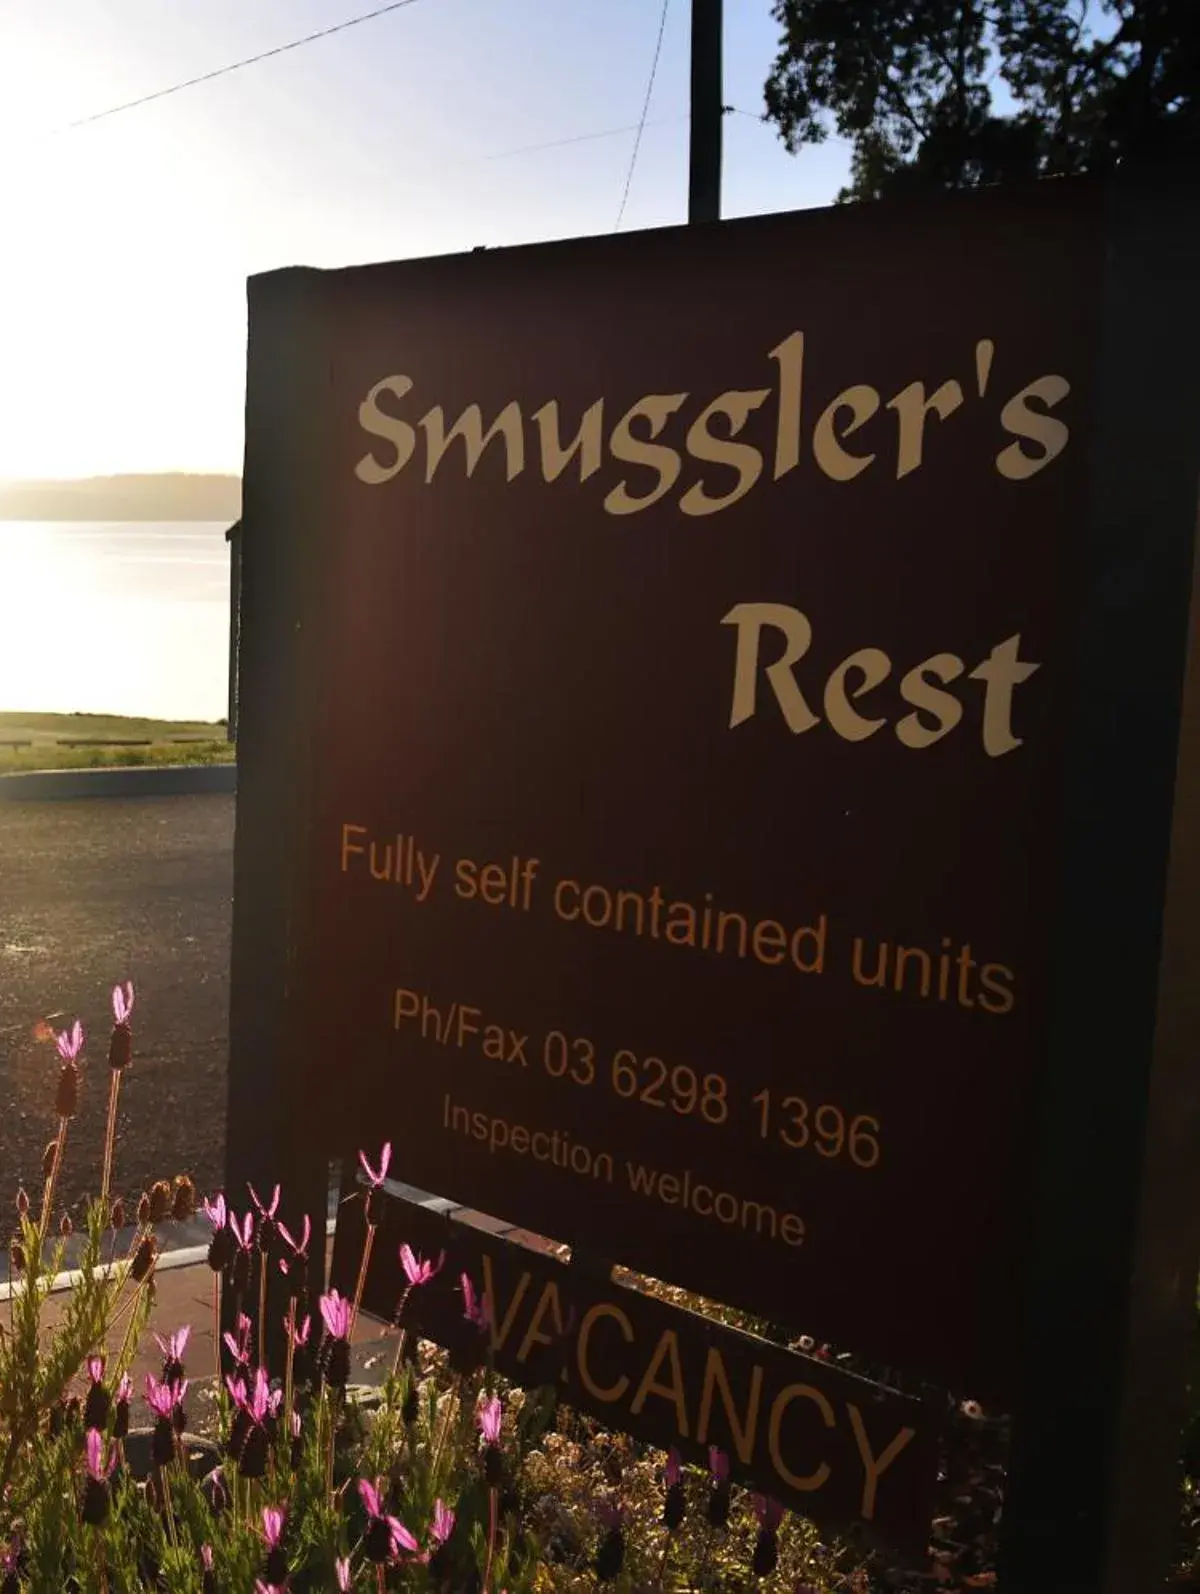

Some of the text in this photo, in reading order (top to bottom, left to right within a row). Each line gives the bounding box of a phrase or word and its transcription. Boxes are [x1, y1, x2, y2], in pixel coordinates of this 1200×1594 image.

[354, 330, 1071, 516] Smuggler's
[721, 602, 1040, 757] Rest
[340, 823, 1016, 1014] Fully self contained units
[394, 988, 881, 1169] Ph/Fax 03 6298 1396
[443, 1094, 807, 1247] Inspection welcome
[481, 1253, 916, 1521] VACANCY
